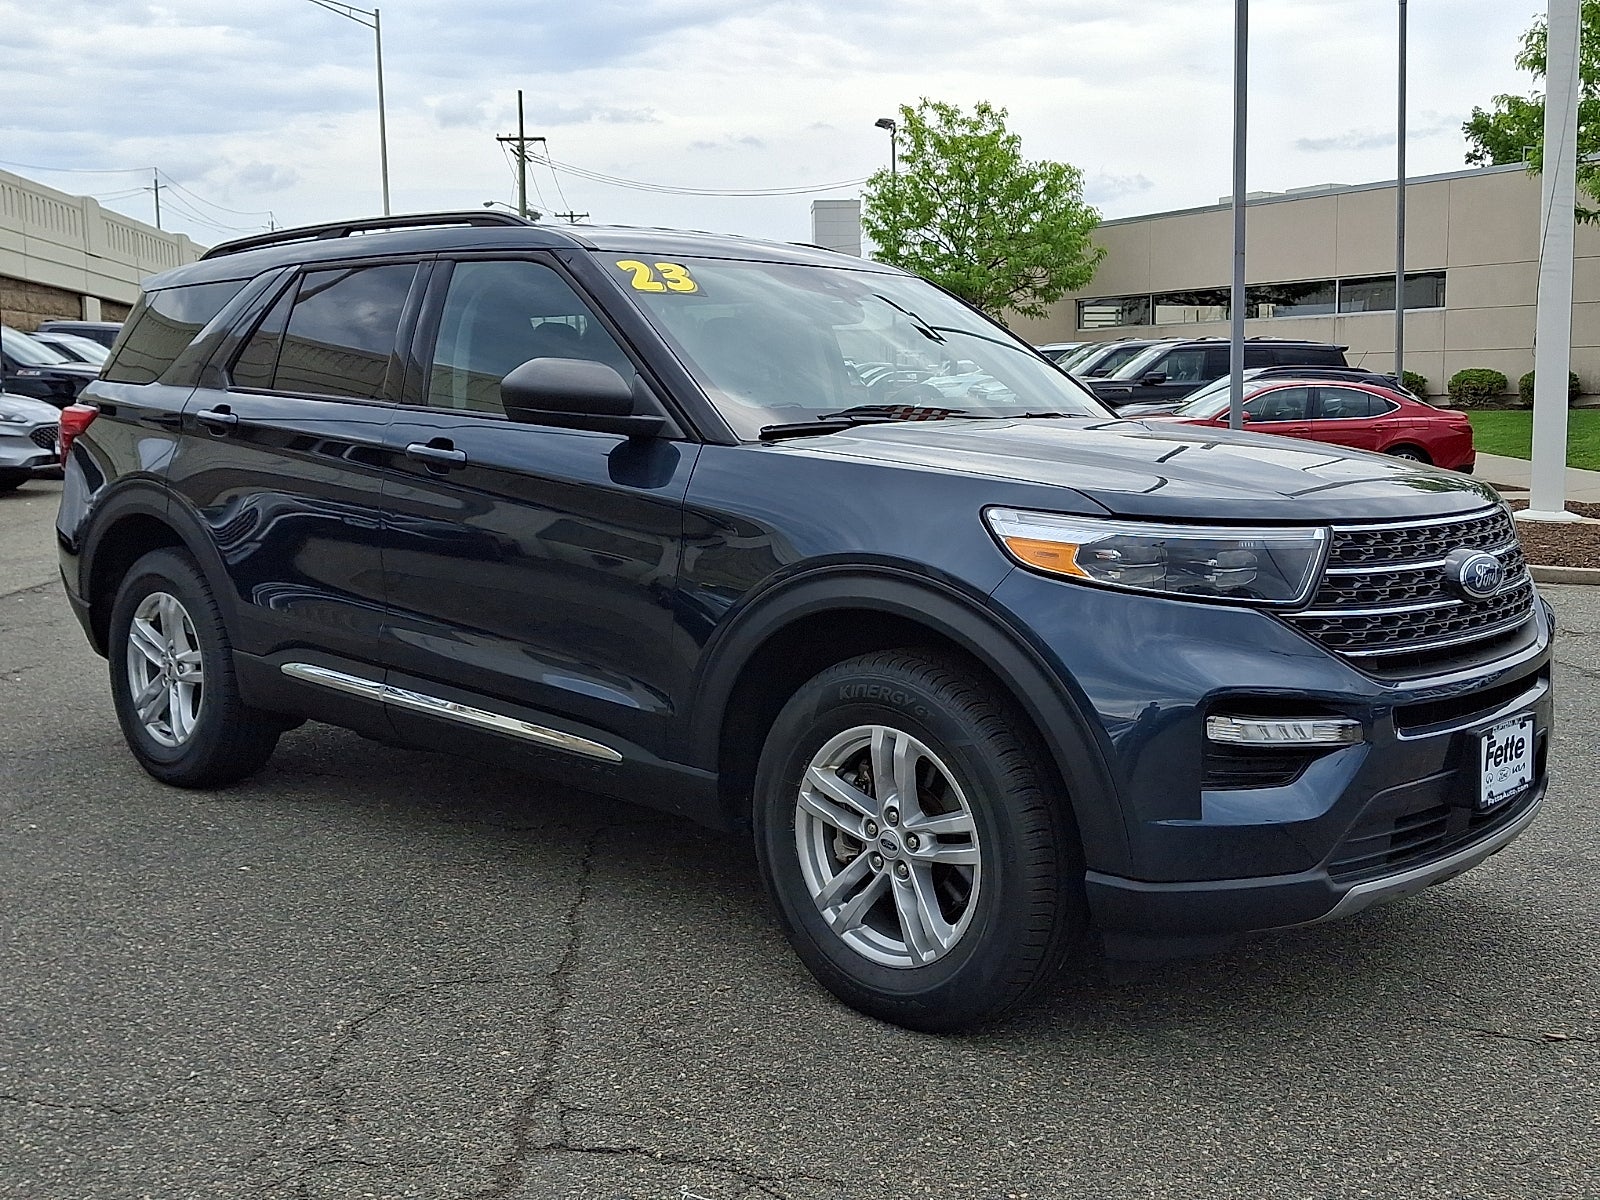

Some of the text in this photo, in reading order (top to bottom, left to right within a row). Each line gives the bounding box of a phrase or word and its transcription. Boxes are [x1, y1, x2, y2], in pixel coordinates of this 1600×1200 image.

[616, 259, 698, 293] 23
[1475, 563, 1500, 588] Ford
[1485, 734, 1525, 772] Fette
